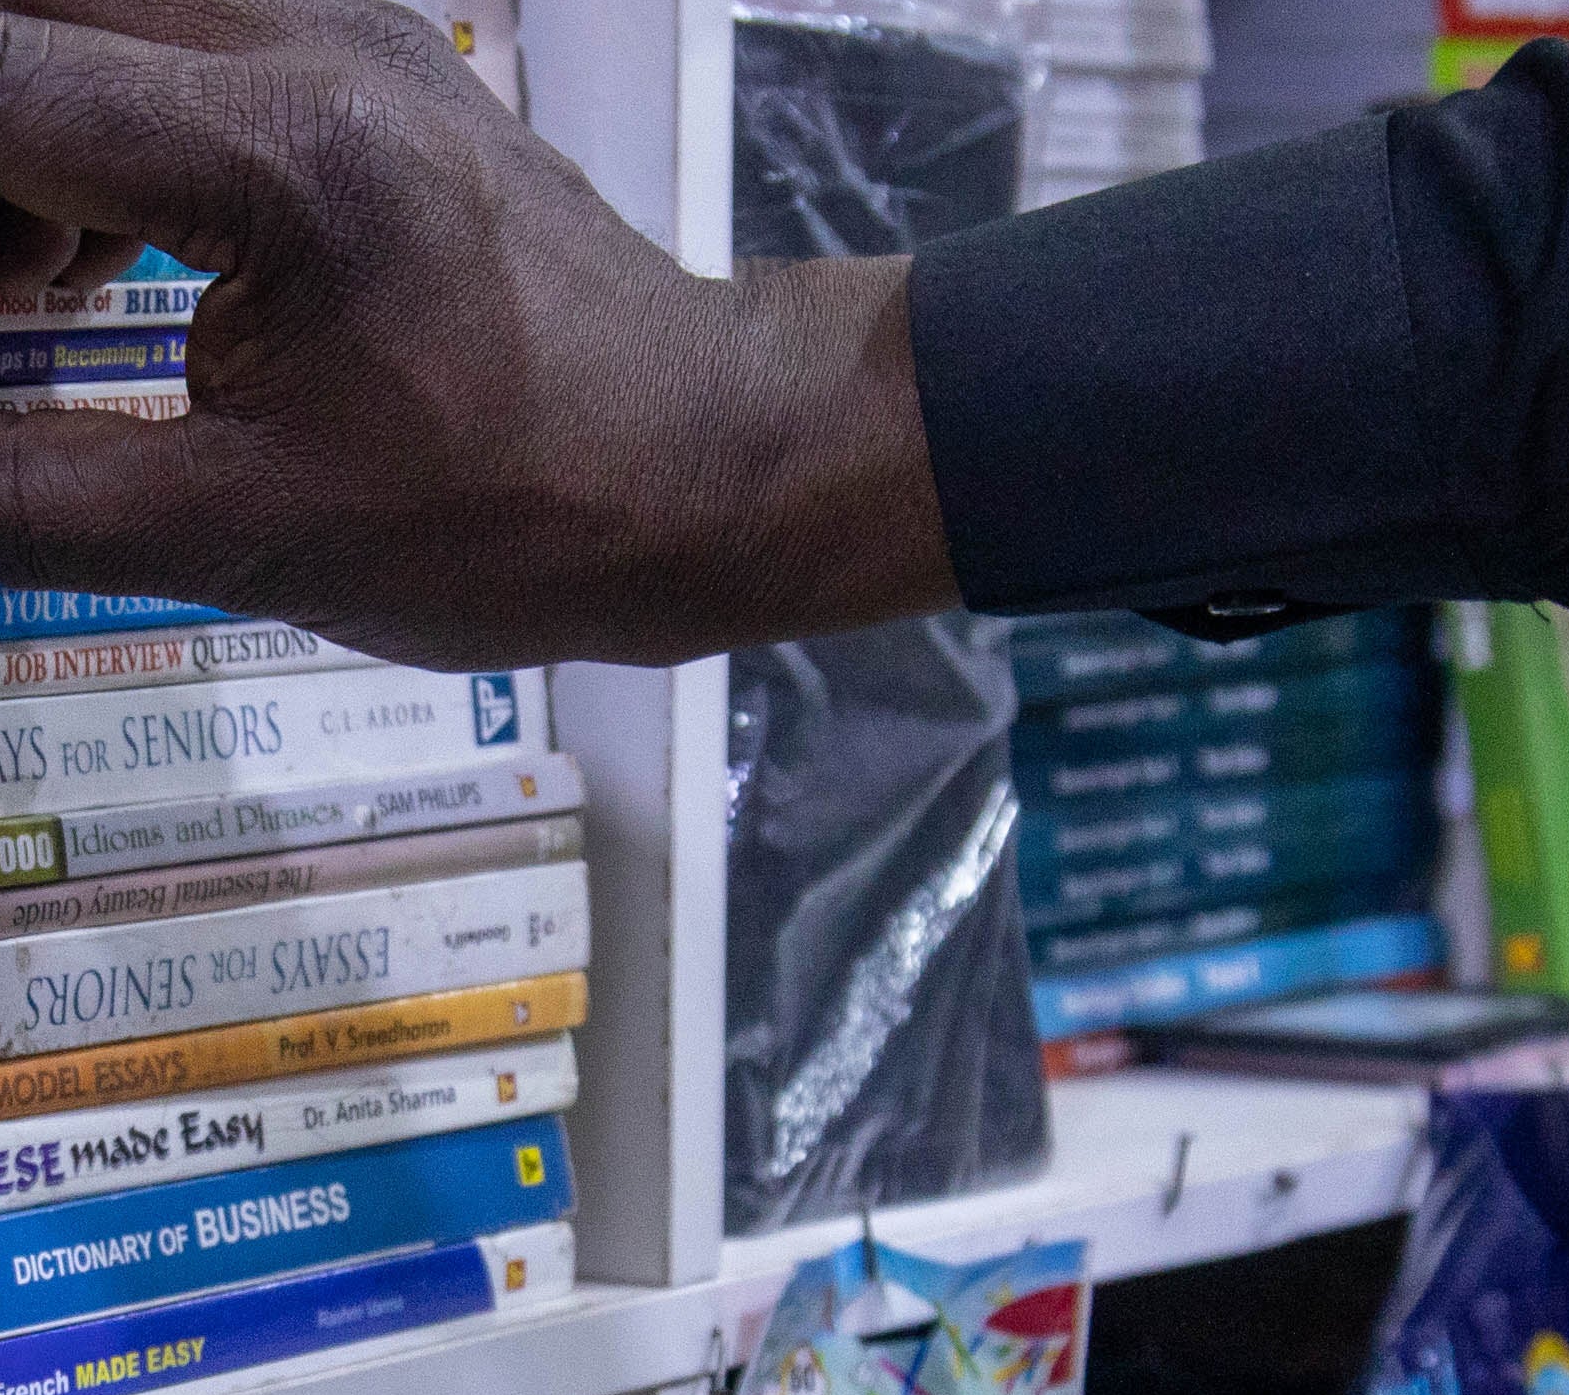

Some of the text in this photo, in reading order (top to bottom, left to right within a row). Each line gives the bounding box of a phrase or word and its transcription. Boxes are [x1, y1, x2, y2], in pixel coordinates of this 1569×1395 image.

[3, 655, 45, 685] JOB
[53, 639, 184, 680] INTERVIEW
[192, 630, 318, 669] QUESTIONS
[63, 742, 111, 776] FOR
[123, 701, 283, 769] SENIORS
[71, 822, 165, 857] Idioms
[177, 814, 225, 842] and
[377, 788, 415, 816] SAM
[418, 782, 483, 809] PHILLIPS
[96, 1050, 188, 1092] ESSAYS
[70, 1126, 168, 1174] made
[178, 1109, 263, 1152] Easy
[303, 1105, 331, 1130] Dr.
[336, 1093, 383, 1123] Anita
[388, 1084, 456, 1115] Sharma
[13, 1230, 152, 1285] DICTIONARY
[158, 1227, 189, 1256] OF
[195, 1184, 350, 1248] BUSINESS
[76, 1350, 140, 1390] MADE
[147, 1338, 205, 1371] EASY
